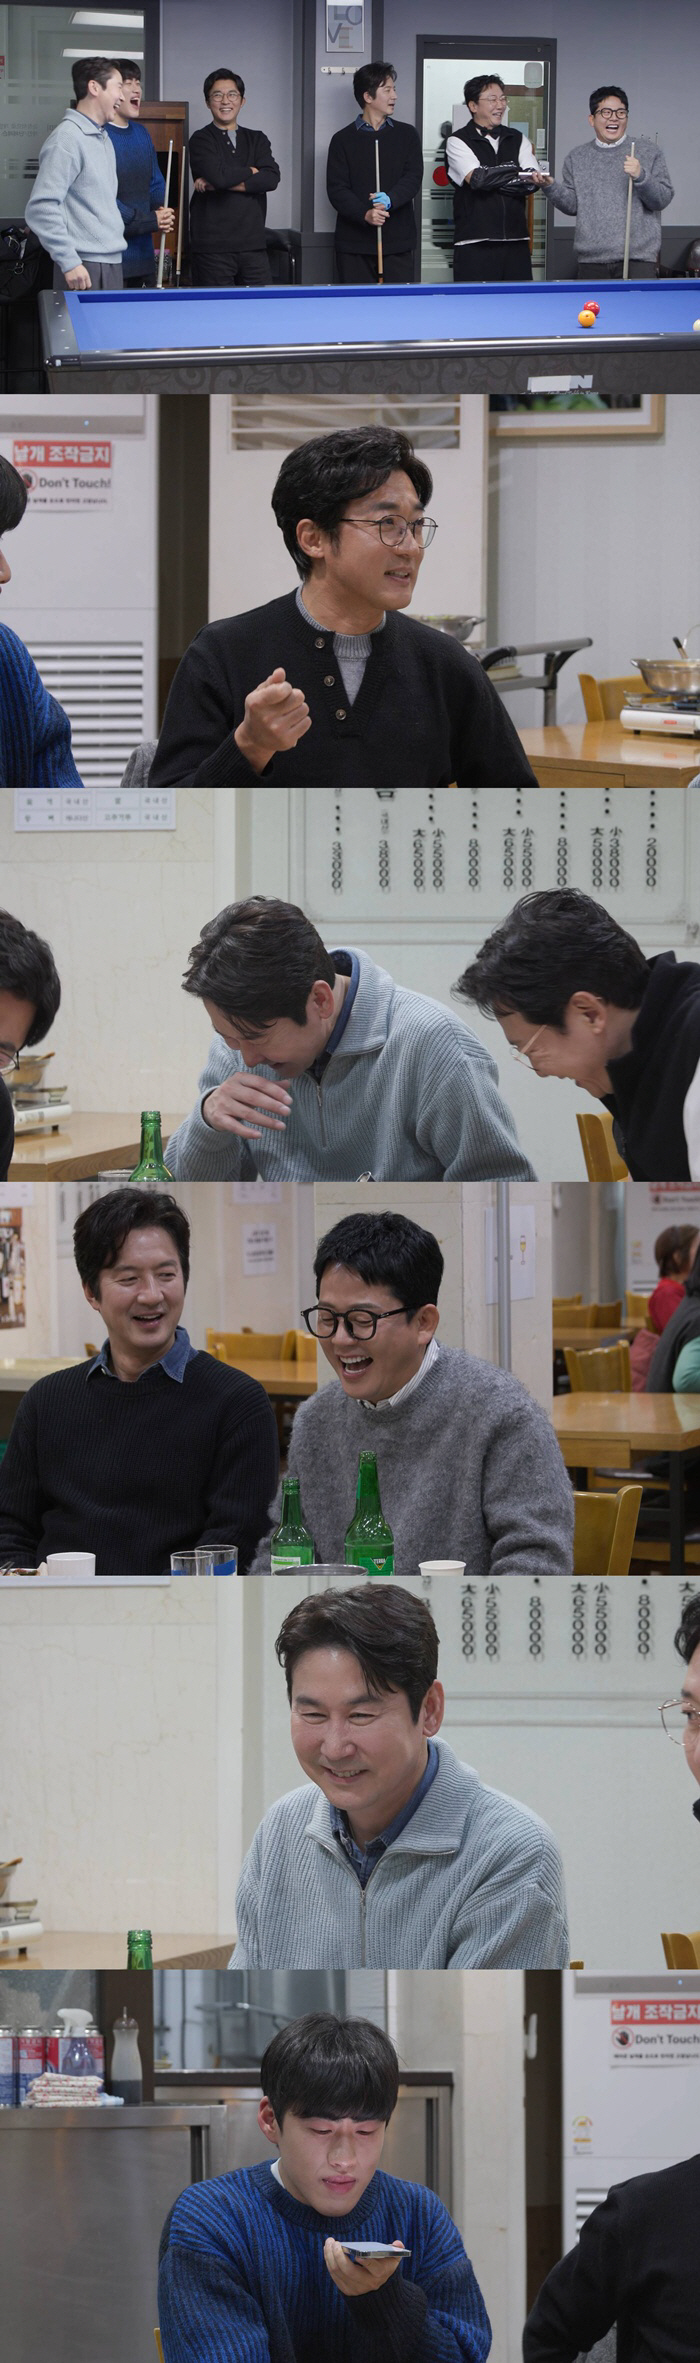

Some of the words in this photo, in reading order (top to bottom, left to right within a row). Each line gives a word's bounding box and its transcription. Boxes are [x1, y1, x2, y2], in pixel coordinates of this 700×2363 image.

[15, 445, 46, 463] 날개
[48, 445, 110, 464] 조작금지
[40, 477, 70, 488] Don't
[73, 477, 112, 488] Touch!
[468, 838, 479, 888] 80000
[556, 837, 567, 887] 80000
[646, 837, 657, 887] 20000
[529, 1596, 541, 1655] 80000
[638, 1594, 650, 1655] 80000
[612, 2003, 641, 2021] 날개
[636, 2034, 663, 2044] Don't
